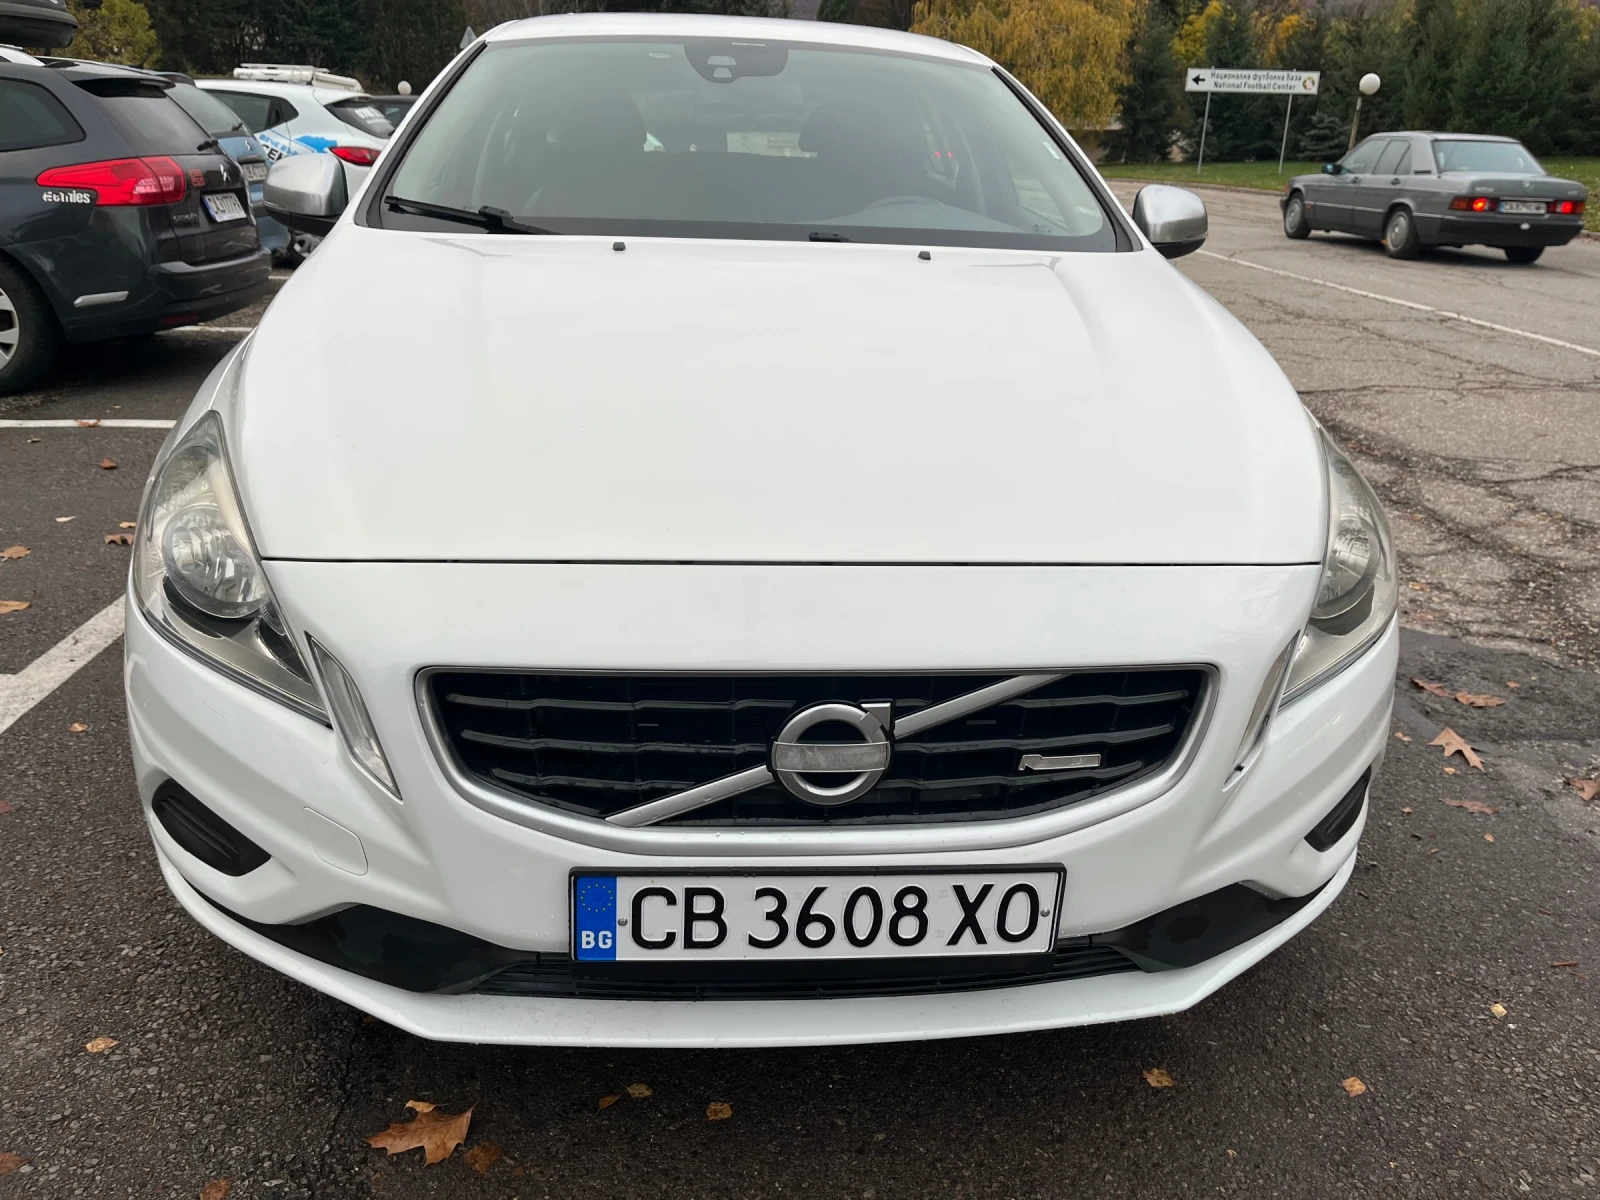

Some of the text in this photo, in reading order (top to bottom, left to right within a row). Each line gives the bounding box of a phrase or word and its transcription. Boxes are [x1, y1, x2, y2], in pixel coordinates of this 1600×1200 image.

[1213, 81, 1296, 90] National Football Center
[630, 882, 1040, 949] CB 3608 XO
[580, 929, 613, 949] BG
